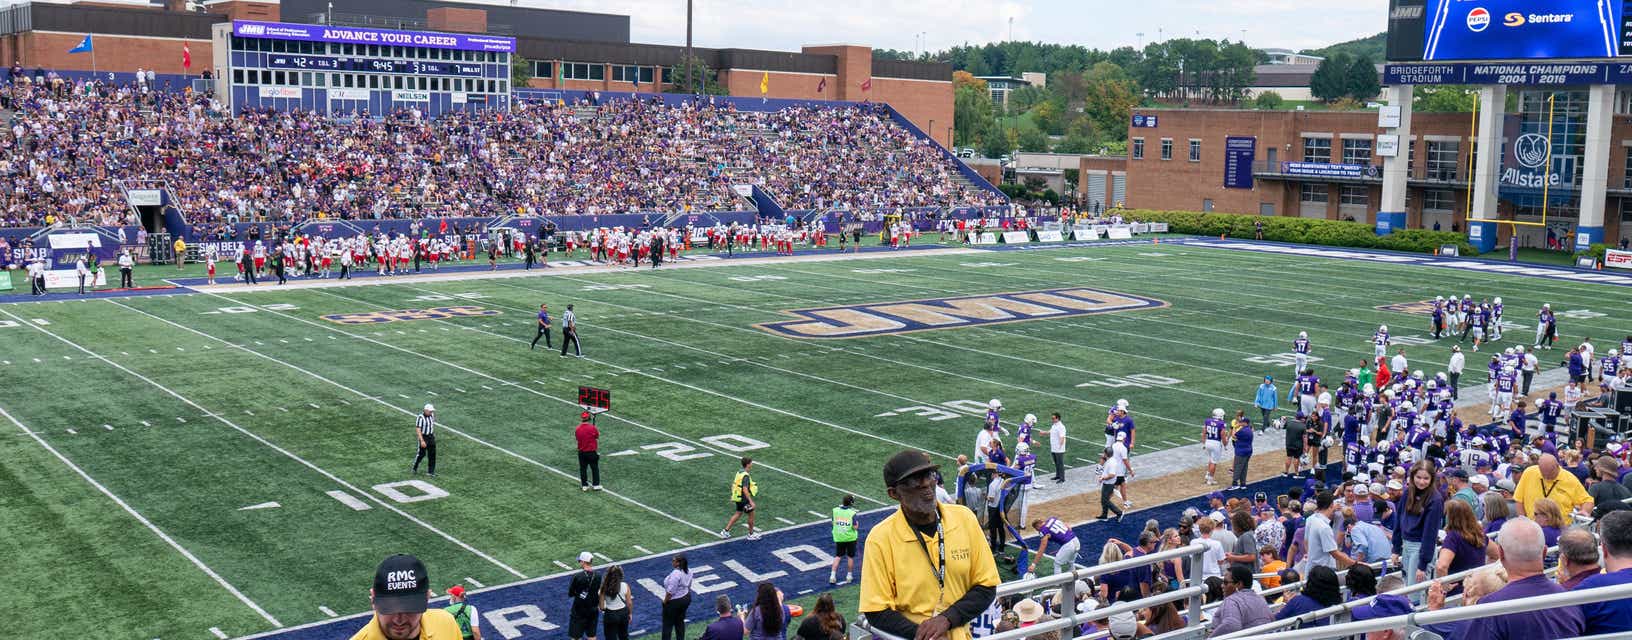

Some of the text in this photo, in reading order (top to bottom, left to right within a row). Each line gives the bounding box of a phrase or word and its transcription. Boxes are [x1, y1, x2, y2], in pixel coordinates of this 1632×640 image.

[1391, 6, 1423, 18] JMU
[1468, 16, 1489, 24] PEPSI
[1528, 13, 1573, 24] Sentara
[239, 24, 266, 35] JMU
[322, 29, 457, 46] ADVANCE YOUR CAREER
[293, 57, 306, 67] 42
[332, 59, 338, 68] 3
[373, 61, 392, 71] 9:45
[413, 64, 419, 74] 3
[421, 64, 426, 72] 3
[455, 65, 461, 73] 7
[1390, 66, 1454, 75] BRIDGEFORTH
[1473, 64, 1597, 74] NATIONAL CHAMPIONS
[1400, 74, 1442, 83] STADIUM
[1498, 74, 1566, 83] 2004 2016
[397, 92, 428, 100] NIELSEN
[1500, 168, 1560, 188] Allstate
[754, 288, 1172, 340] JMU
[1297, 343, 1306, 352] 17
[1603, 362, 1615, 373] 55
[1300, 381, 1311, 392] 77
[1500, 379, 1512, 390] 40
[1206, 425, 1218, 438] 94
[640, 433, 771, 462] 20
[325, 479, 451, 512] 10
[387, 569, 417, 583] RMC
[387, 580, 418, 591] EVENTS
